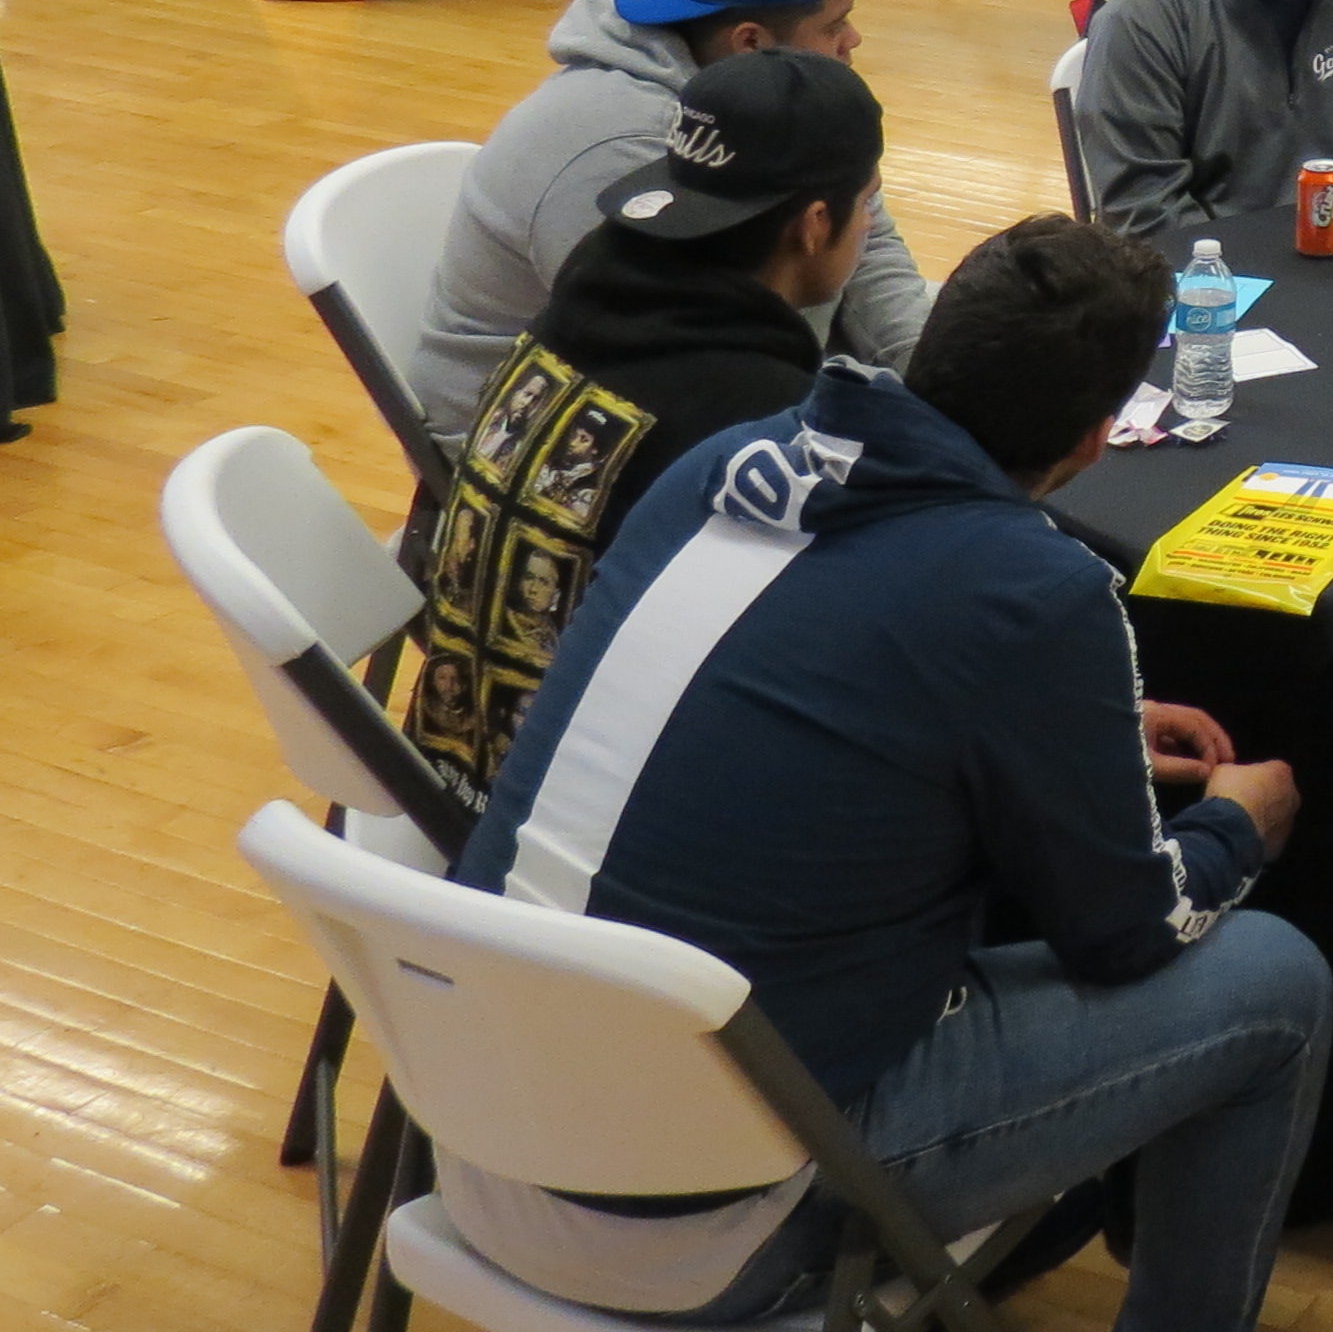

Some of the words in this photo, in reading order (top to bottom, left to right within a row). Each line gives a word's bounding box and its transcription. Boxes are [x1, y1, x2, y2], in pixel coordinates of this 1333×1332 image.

[665, 101, 737, 168] Bulls
[1200, 526, 1246, 539] THING
[1245, 532, 1292, 545] SINCE
[1291, 538, 1331, 550] 1952
[1208, 519, 1259, 534] DOING
[1260, 525, 1294, 536] THE
